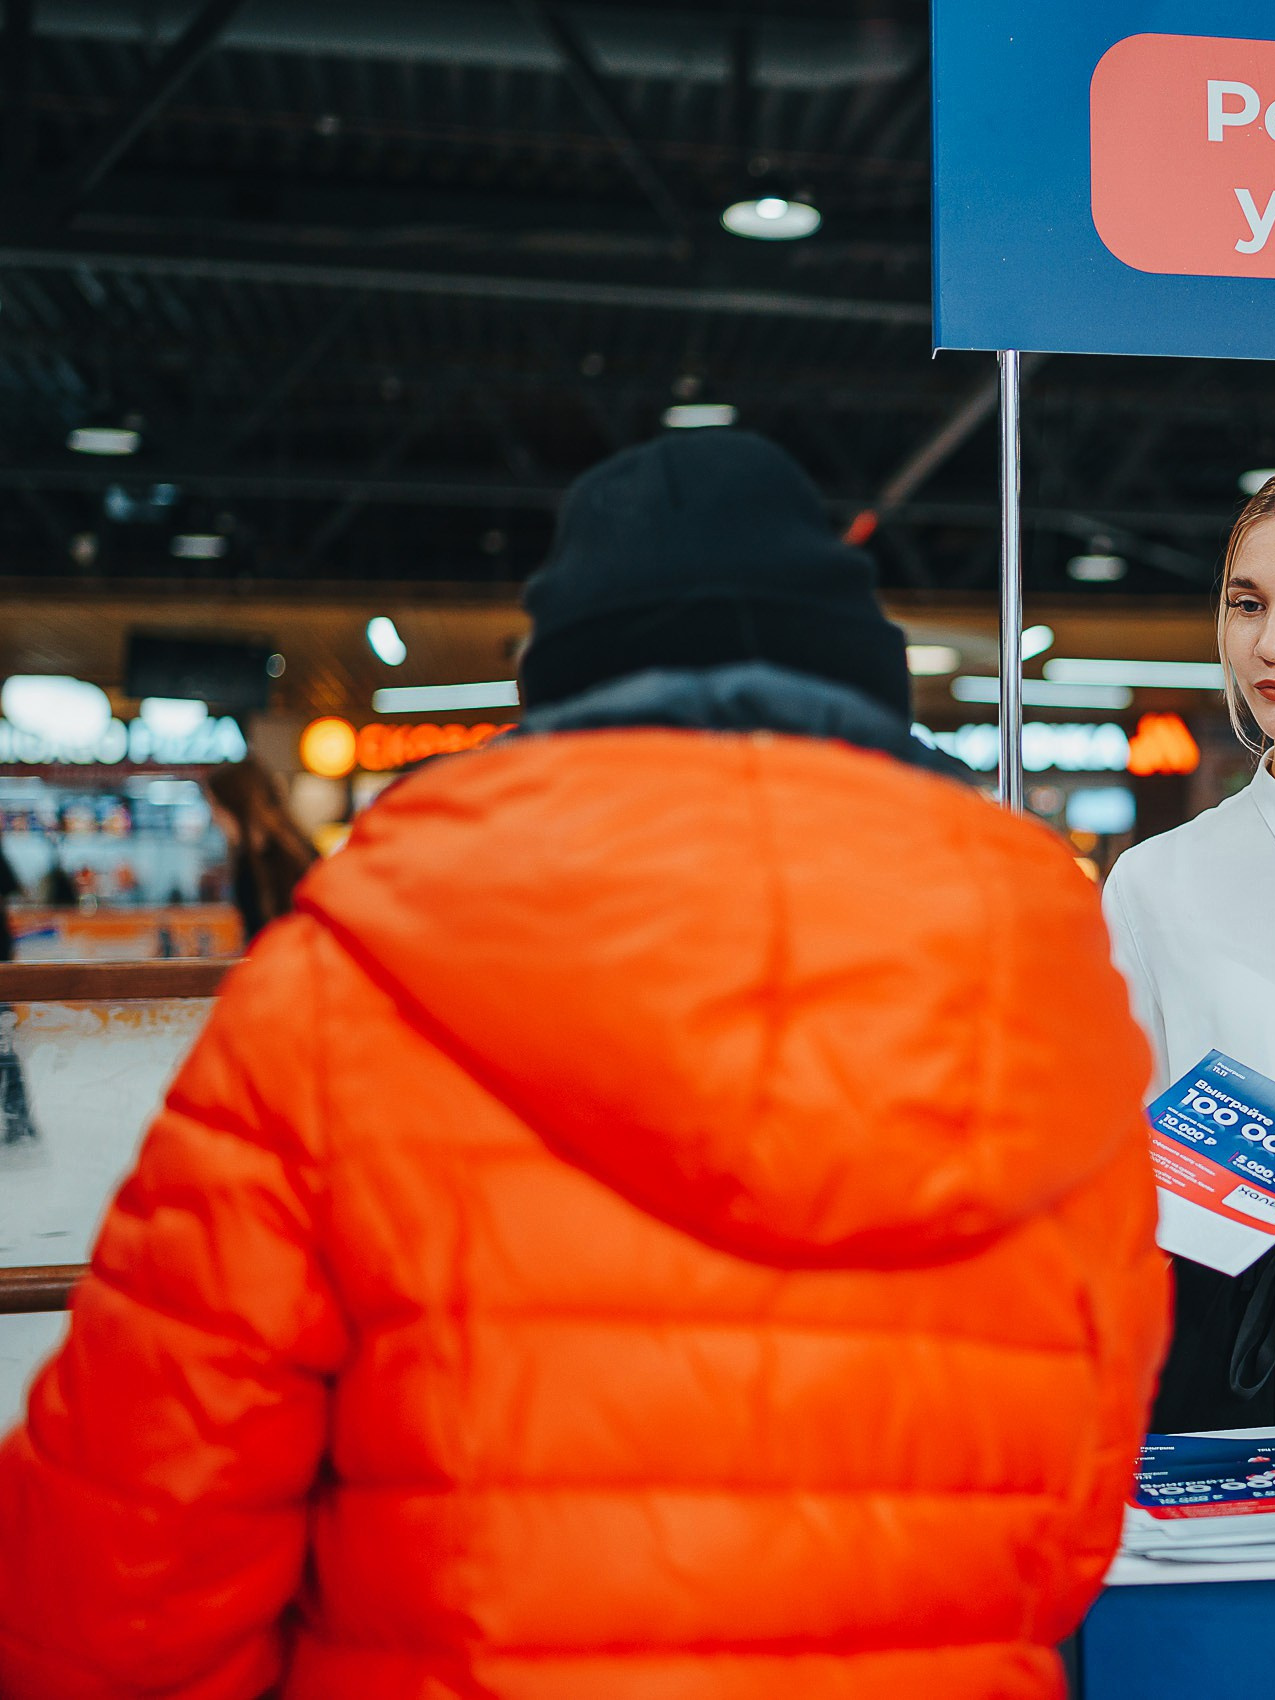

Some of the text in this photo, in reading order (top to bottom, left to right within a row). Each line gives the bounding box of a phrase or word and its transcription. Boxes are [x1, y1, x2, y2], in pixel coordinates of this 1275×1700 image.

[1181, 1088, 1239, 1126] 100
[1194, 1079, 1274, 1127] Выиграйте
[1163, 1114, 1179, 1126] 10
[1178, 1123, 1205, 1140] 000
[1235, 1154, 1274, 1178] 5 000
[1144, 1484, 1212, 1496] 100
